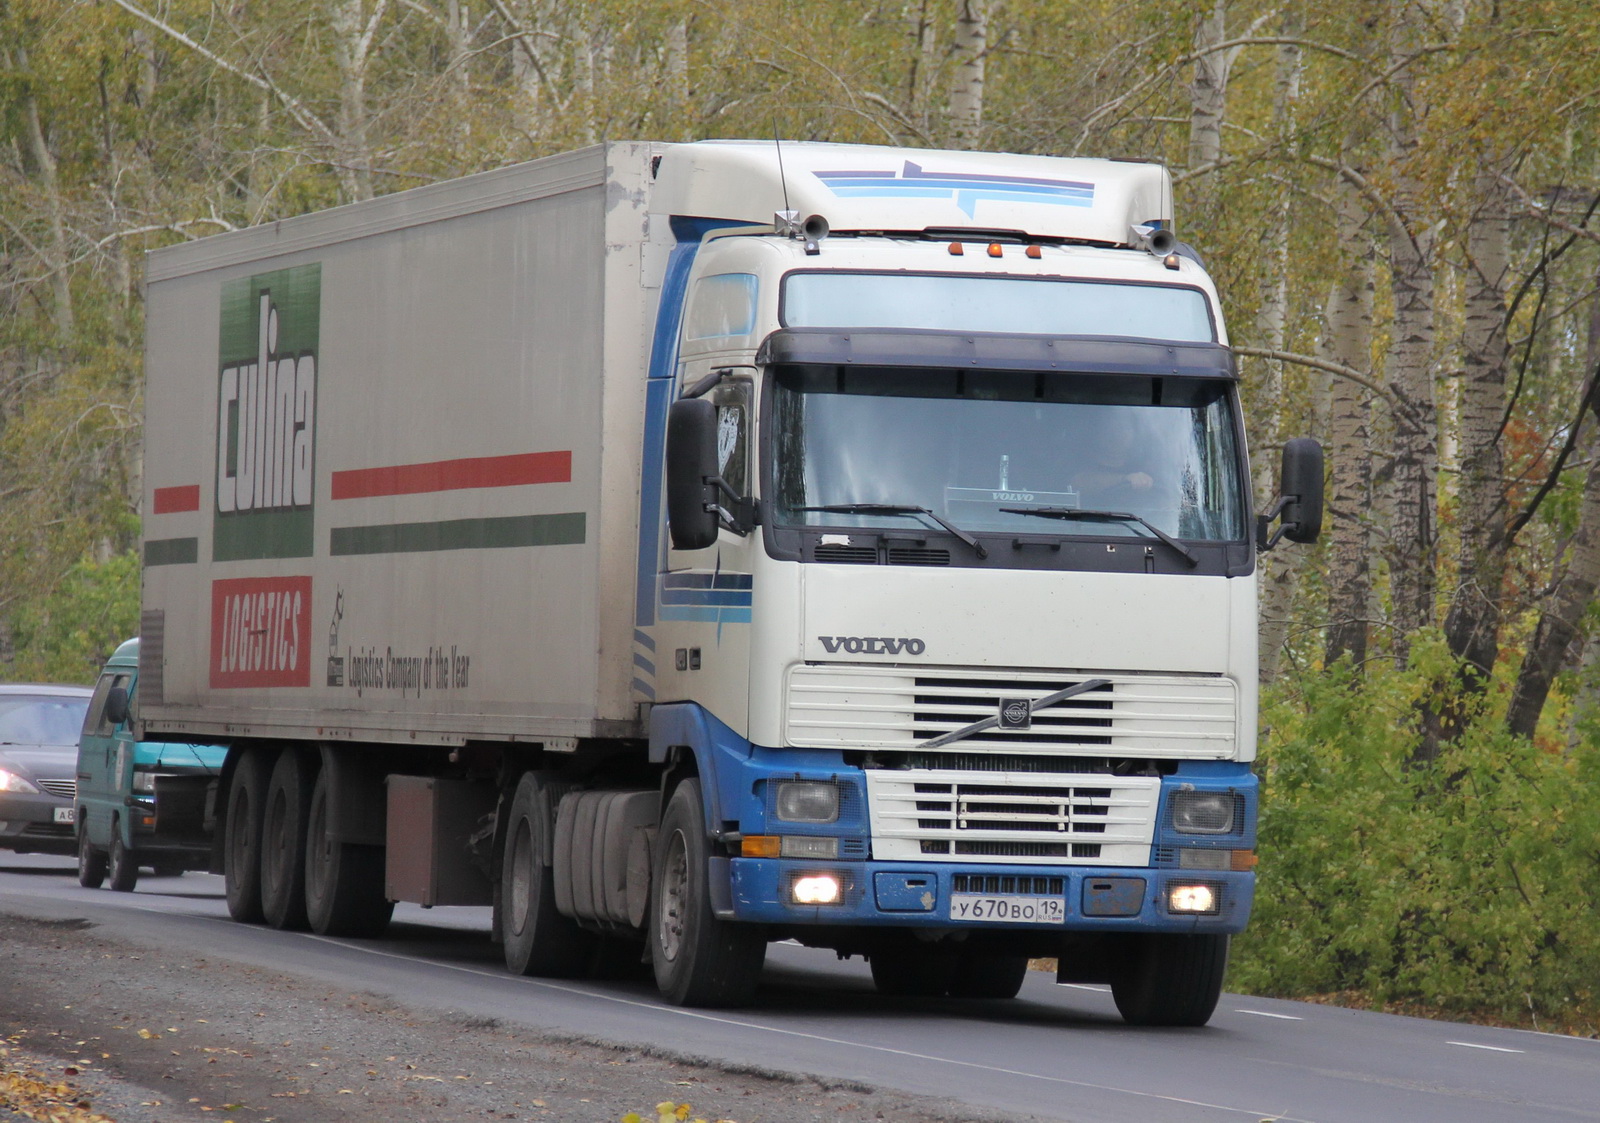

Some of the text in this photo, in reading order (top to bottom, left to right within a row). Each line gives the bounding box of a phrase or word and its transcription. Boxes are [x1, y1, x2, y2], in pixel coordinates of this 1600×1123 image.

[217, 289, 315, 513] culina
[992, 492, 1034, 502] VOLVO
[220, 590, 302, 673] LOGISTICS
[818, 636, 926, 655] VOLVO
[349, 646, 384, 698] Logistics
[386, 646, 422, 699] Company
[423, 646, 433, 690] of
[435, 646, 449, 690] the
[451, 645, 470, 688] Year
